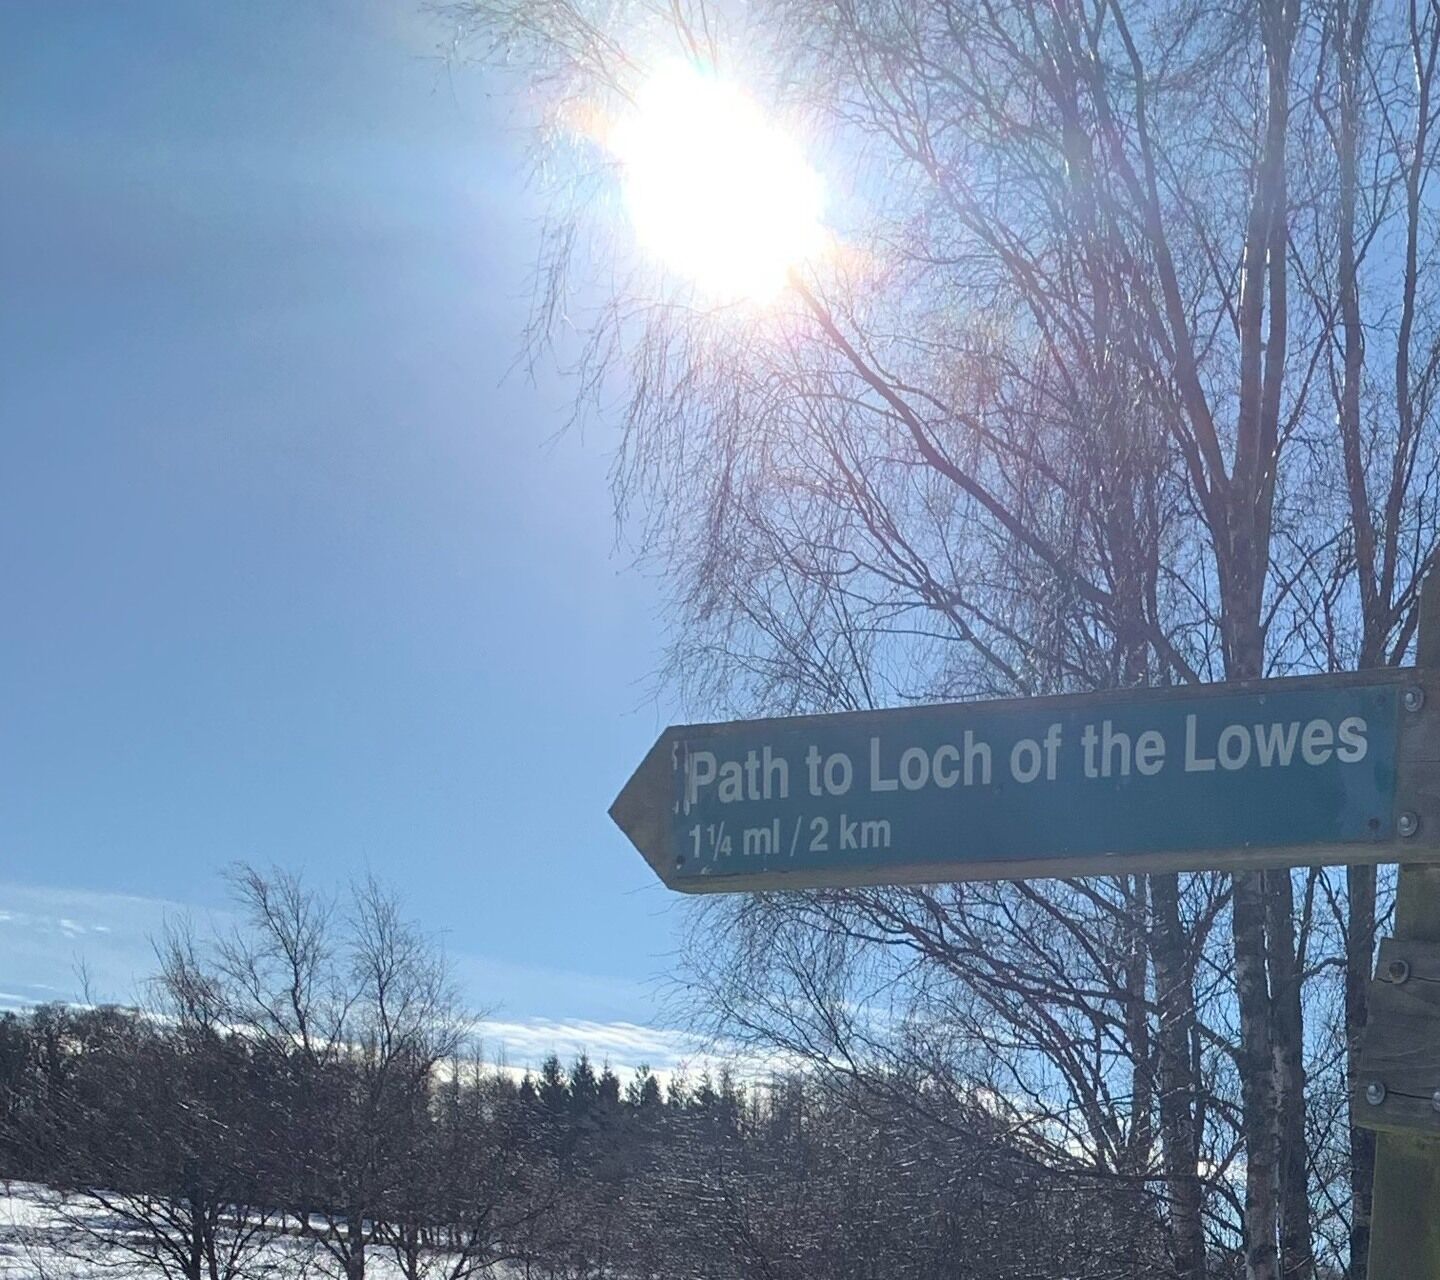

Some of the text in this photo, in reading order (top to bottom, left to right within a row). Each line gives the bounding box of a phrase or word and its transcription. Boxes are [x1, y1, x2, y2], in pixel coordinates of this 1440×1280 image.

[690, 715, 1368, 804] Path to Loch of the Lowes
[743, 818, 780, 855] ml
[809, 816, 829, 852] 2
[840, 814, 891, 850] km
